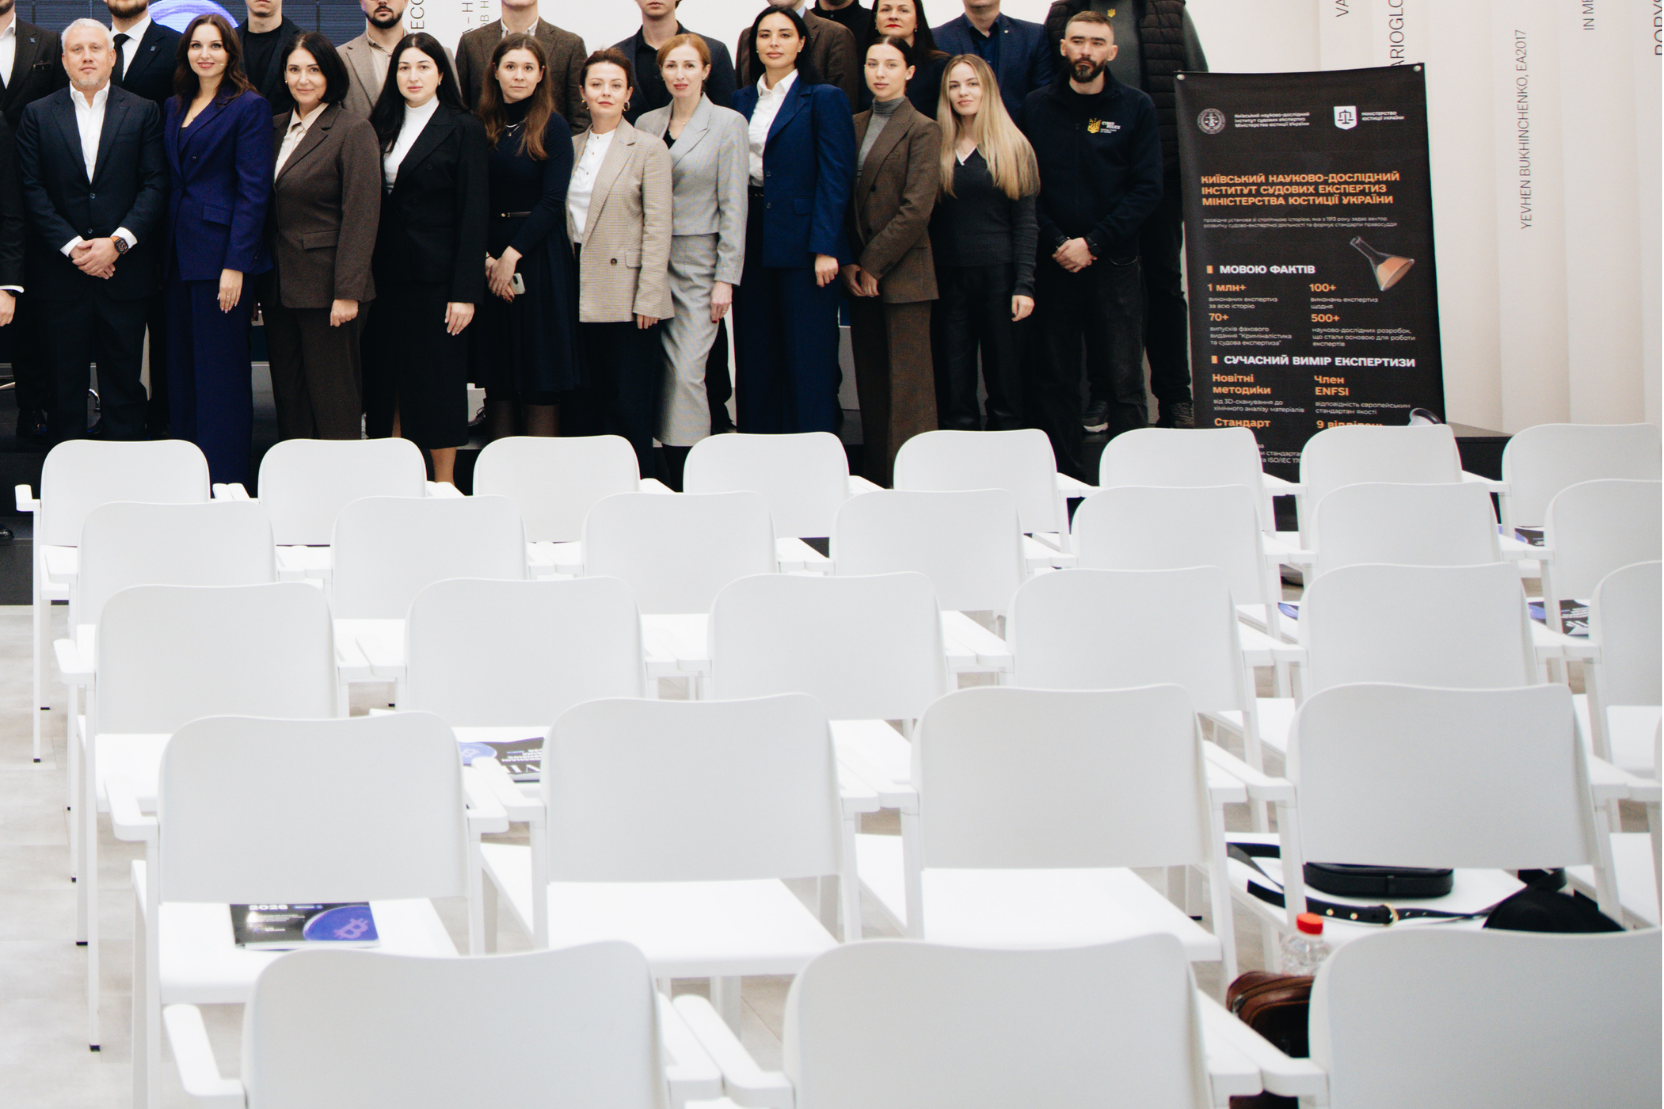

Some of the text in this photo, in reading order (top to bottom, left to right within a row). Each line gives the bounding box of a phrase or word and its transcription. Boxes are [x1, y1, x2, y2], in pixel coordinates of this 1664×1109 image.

[1583, 18, 1595, 31] IN
[1515, 29, 1532, 230] YEVHEN BUKHINCHENKO, EA2017
[1201, 171, 1400, 184] КИЇВСЬКИЙ НАУКОВО-ДОСЛІДНИЙ
[1202, 184, 1387, 196] ІНСТИТУТ СУДОВИХ ЕКСПЕРТИЗ
[1202, 194, 1393, 206] МІНІСТЕРСТВА ЮСТИЦІЇ УКРАЇНИ
[1219, 265, 1316, 274] МОВОЮ ФАКТІВ
[1207, 283, 1246, 292] 1 млн+
[1309, 283, 1336, 292] 100+
[1208, 313, 1229, 321] 70+
[1311, 314, 1340, 322] 500+
[1224, 354, 1416, 367] СУЧАСНИЙ ВИМІР ЕКСПЕРТИЗИ
[1212, 374, 1254, 383] Новітні
[1314, 375, 1344, 384] Член
[1212, 386, 1272, 395] методики
[1315, 387, 1349, 396] ENFSI
[1214, 417, 1271, 429] Стандарт
[1316, 420, 1324, 429] 9
